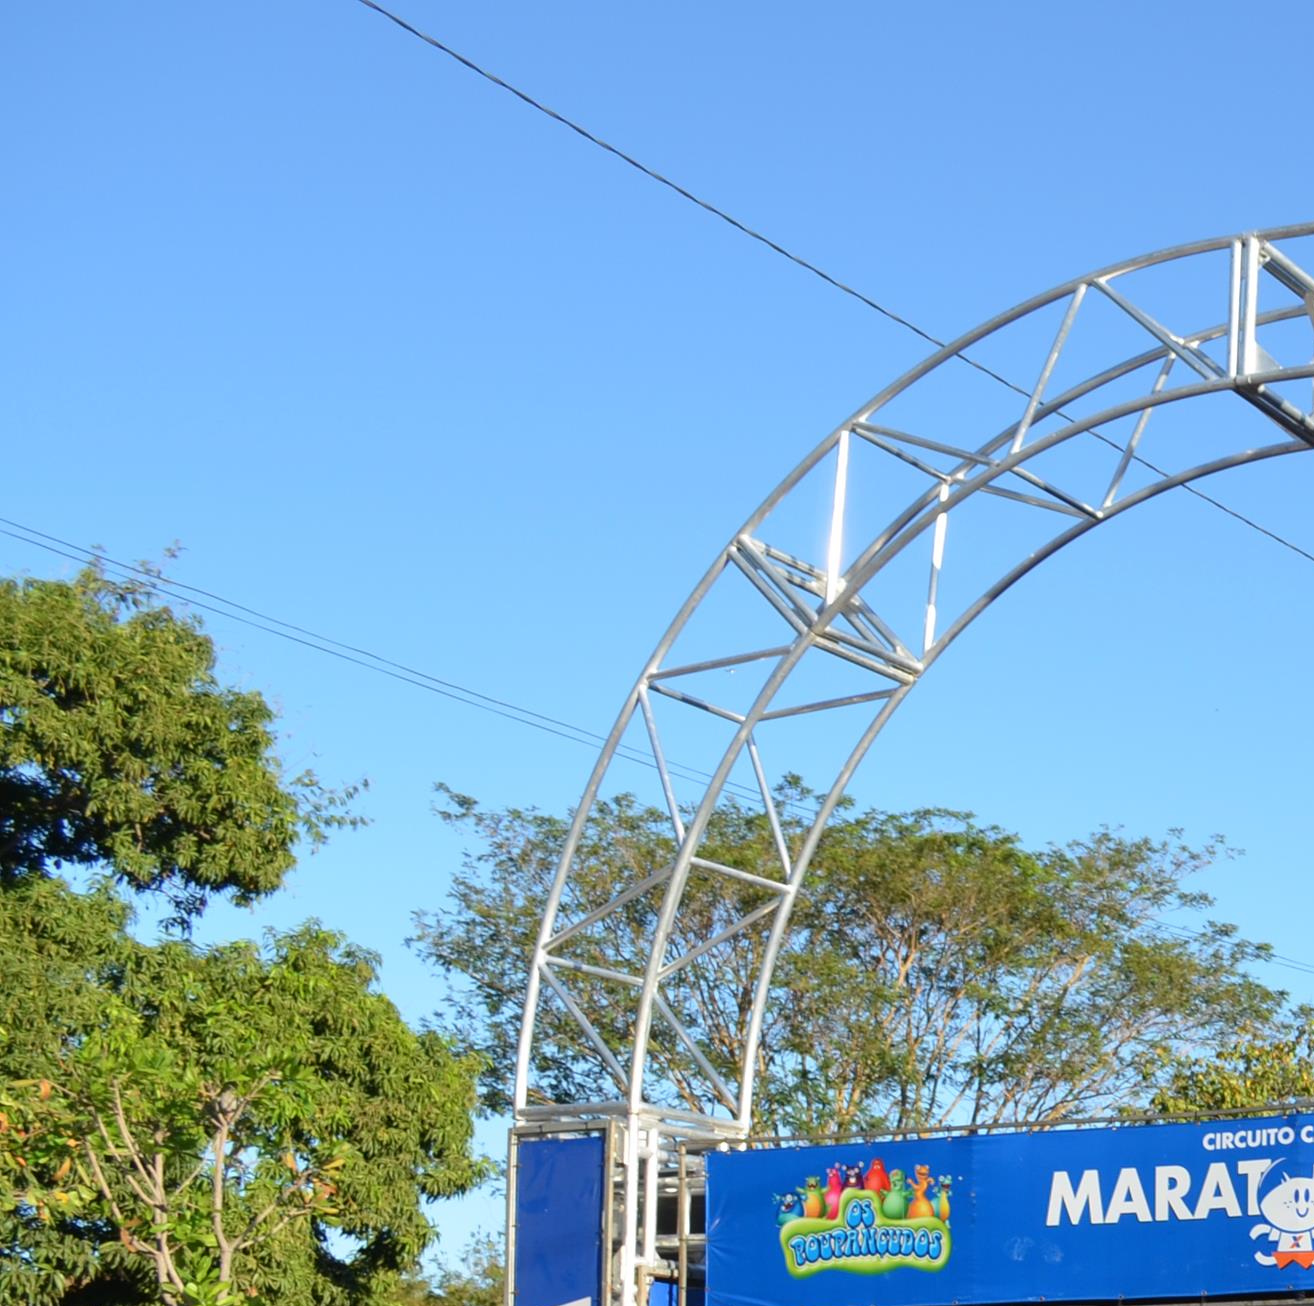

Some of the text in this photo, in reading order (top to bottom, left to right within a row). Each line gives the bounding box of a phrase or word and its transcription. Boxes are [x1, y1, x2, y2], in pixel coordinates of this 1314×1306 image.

[1202, 1126, 1295, 1150] CIRCUITO
[846, 1200, 875, 1228] OS
[790, 1228, 943, 1266] POUPANÇUDOS
